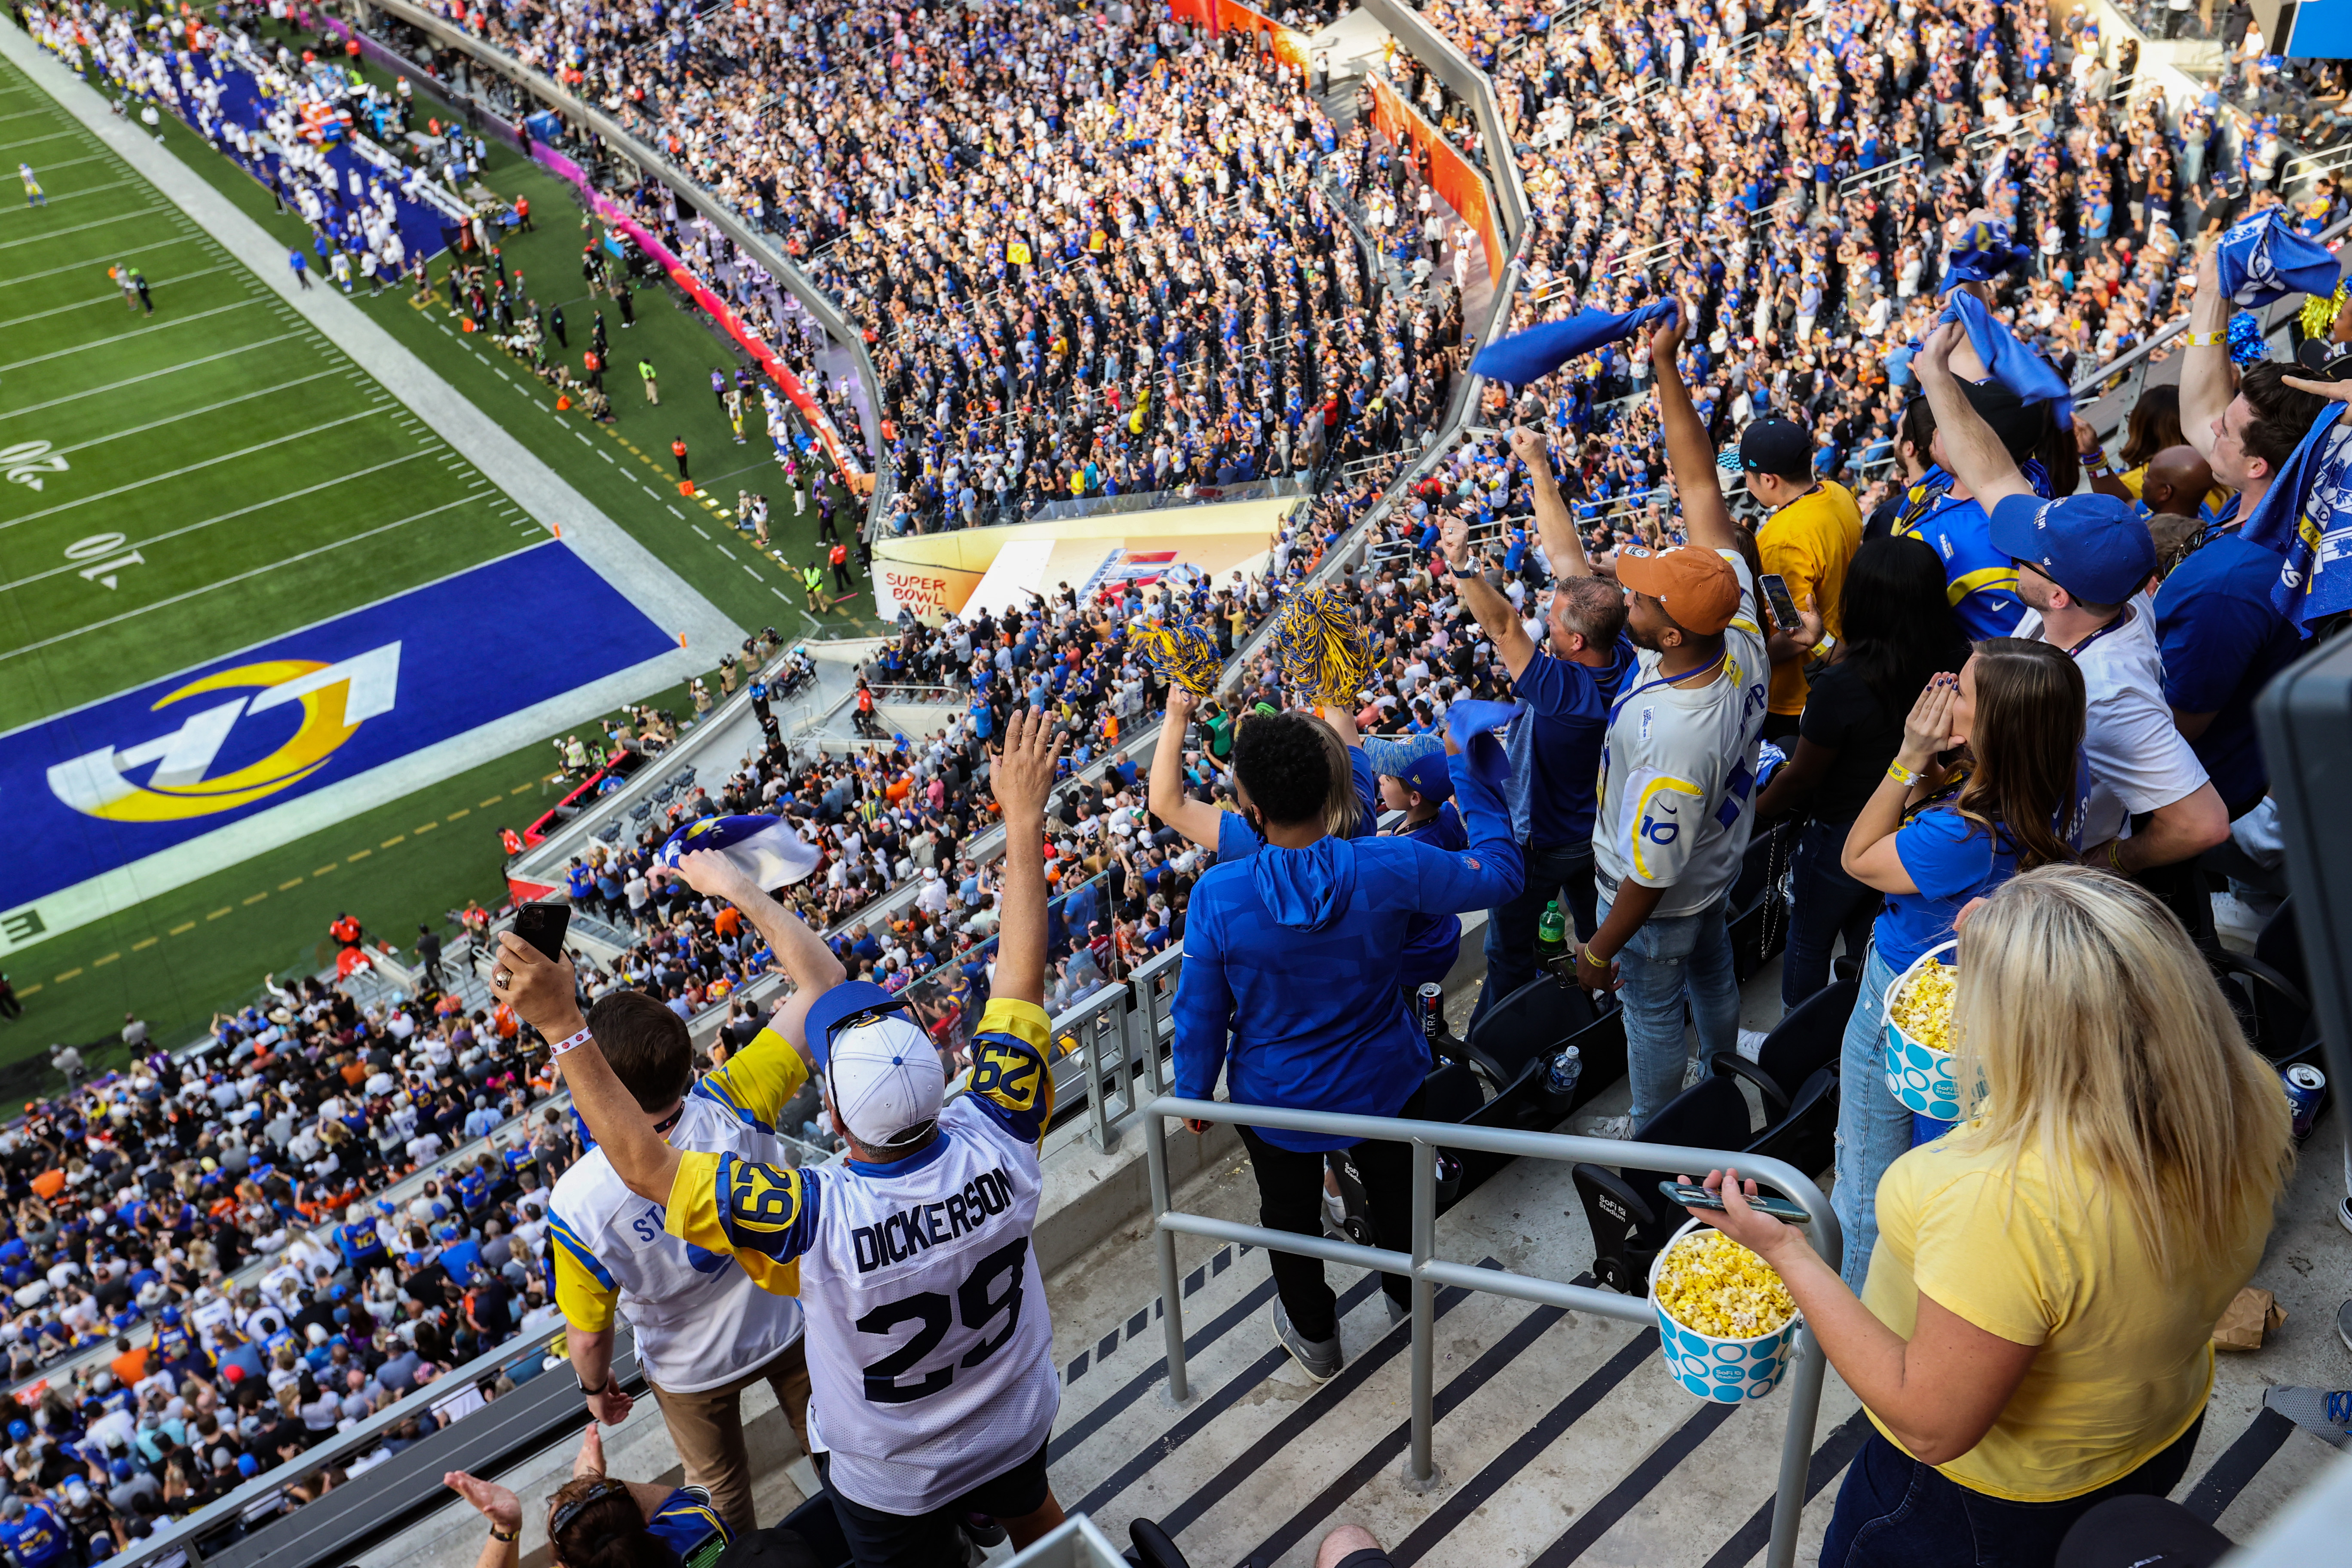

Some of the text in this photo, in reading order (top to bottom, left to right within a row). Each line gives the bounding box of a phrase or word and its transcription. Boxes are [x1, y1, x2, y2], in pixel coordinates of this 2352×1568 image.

[1939, 533, 1951, 559] RAMS
[886, 573, 946, 592] SUPER
[1076, 557, 1117, 608] SUPER BO
[893, 588, 945, 605] BOWL
[1892, 766, 1902, 777] BUS
[1641, 815, 1679, 845] 10
[1427, 1013, 1436, 1037] LTRA
[1345, 1162, 1359, 1177] SoFi
[732, 1162, 793, 1225] 29
[1599, 1194, 1617, 1211] SoFi
[633, 1204, 666, 1242] ST
[851, 1167, 1015, 1273] DICKERSON
[1599, 1201, 1625, 1222] Stadium
[1607, 1271, 1614, 1283] 4
[855, 1236, 1029, 1403] 29
